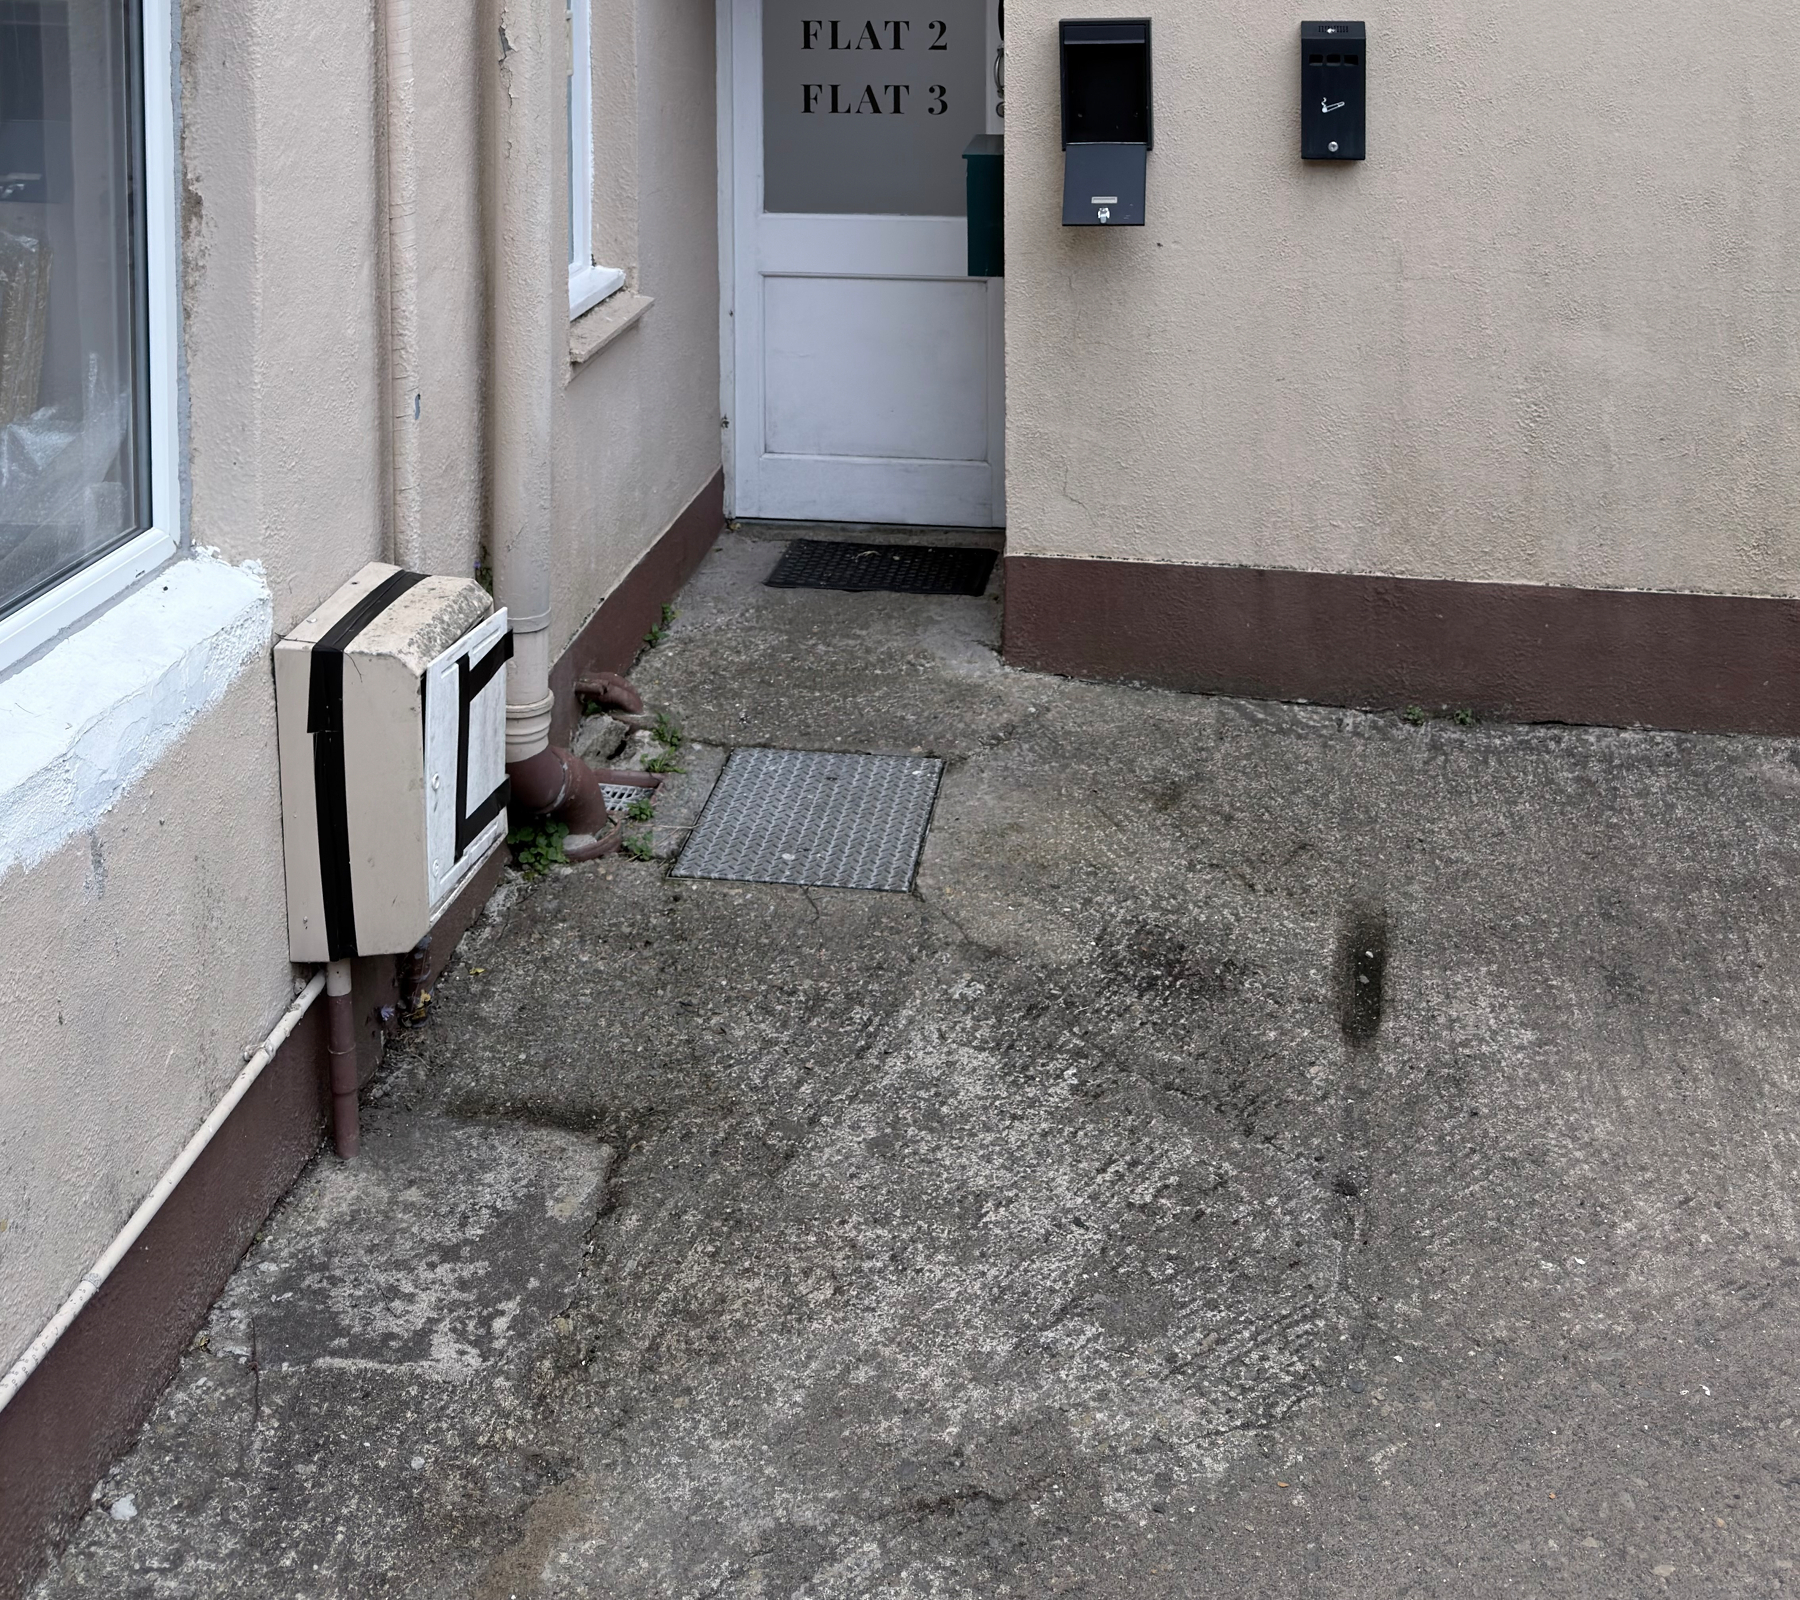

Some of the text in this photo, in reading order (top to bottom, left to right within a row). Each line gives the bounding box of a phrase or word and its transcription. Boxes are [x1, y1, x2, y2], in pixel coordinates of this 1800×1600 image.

[800, 19, 949, 51] FLAT 2
[800, 83, 949, 116] FLAT 3
